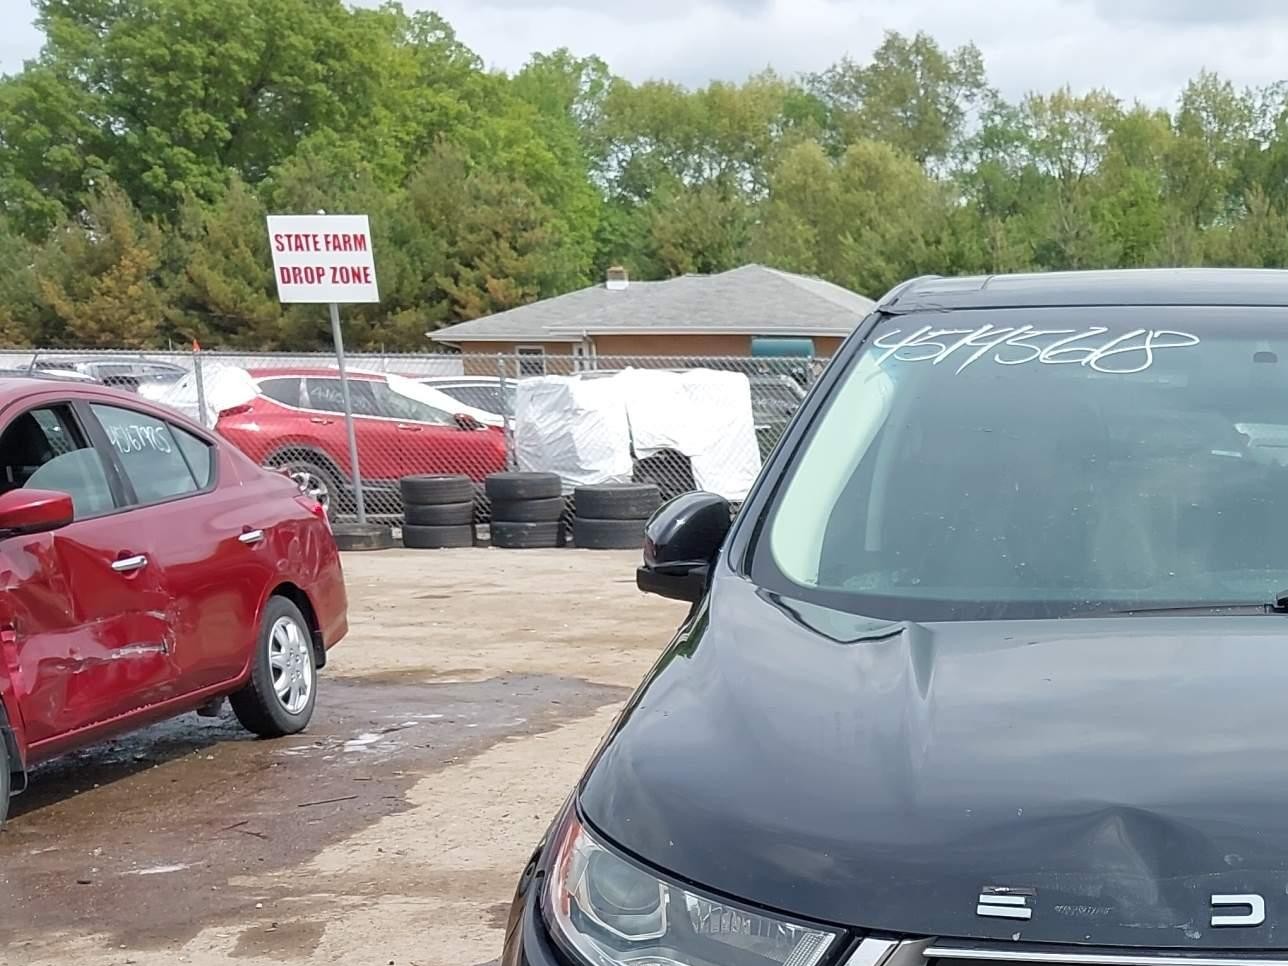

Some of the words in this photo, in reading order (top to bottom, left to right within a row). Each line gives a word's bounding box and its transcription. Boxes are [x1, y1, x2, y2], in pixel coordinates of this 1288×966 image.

[274, 233, 321, 252] STATE
[323, 233, 367, 252] FARM
[279, 266, 325, 284] DROP
[329, 266, 372, 284] ZONE
